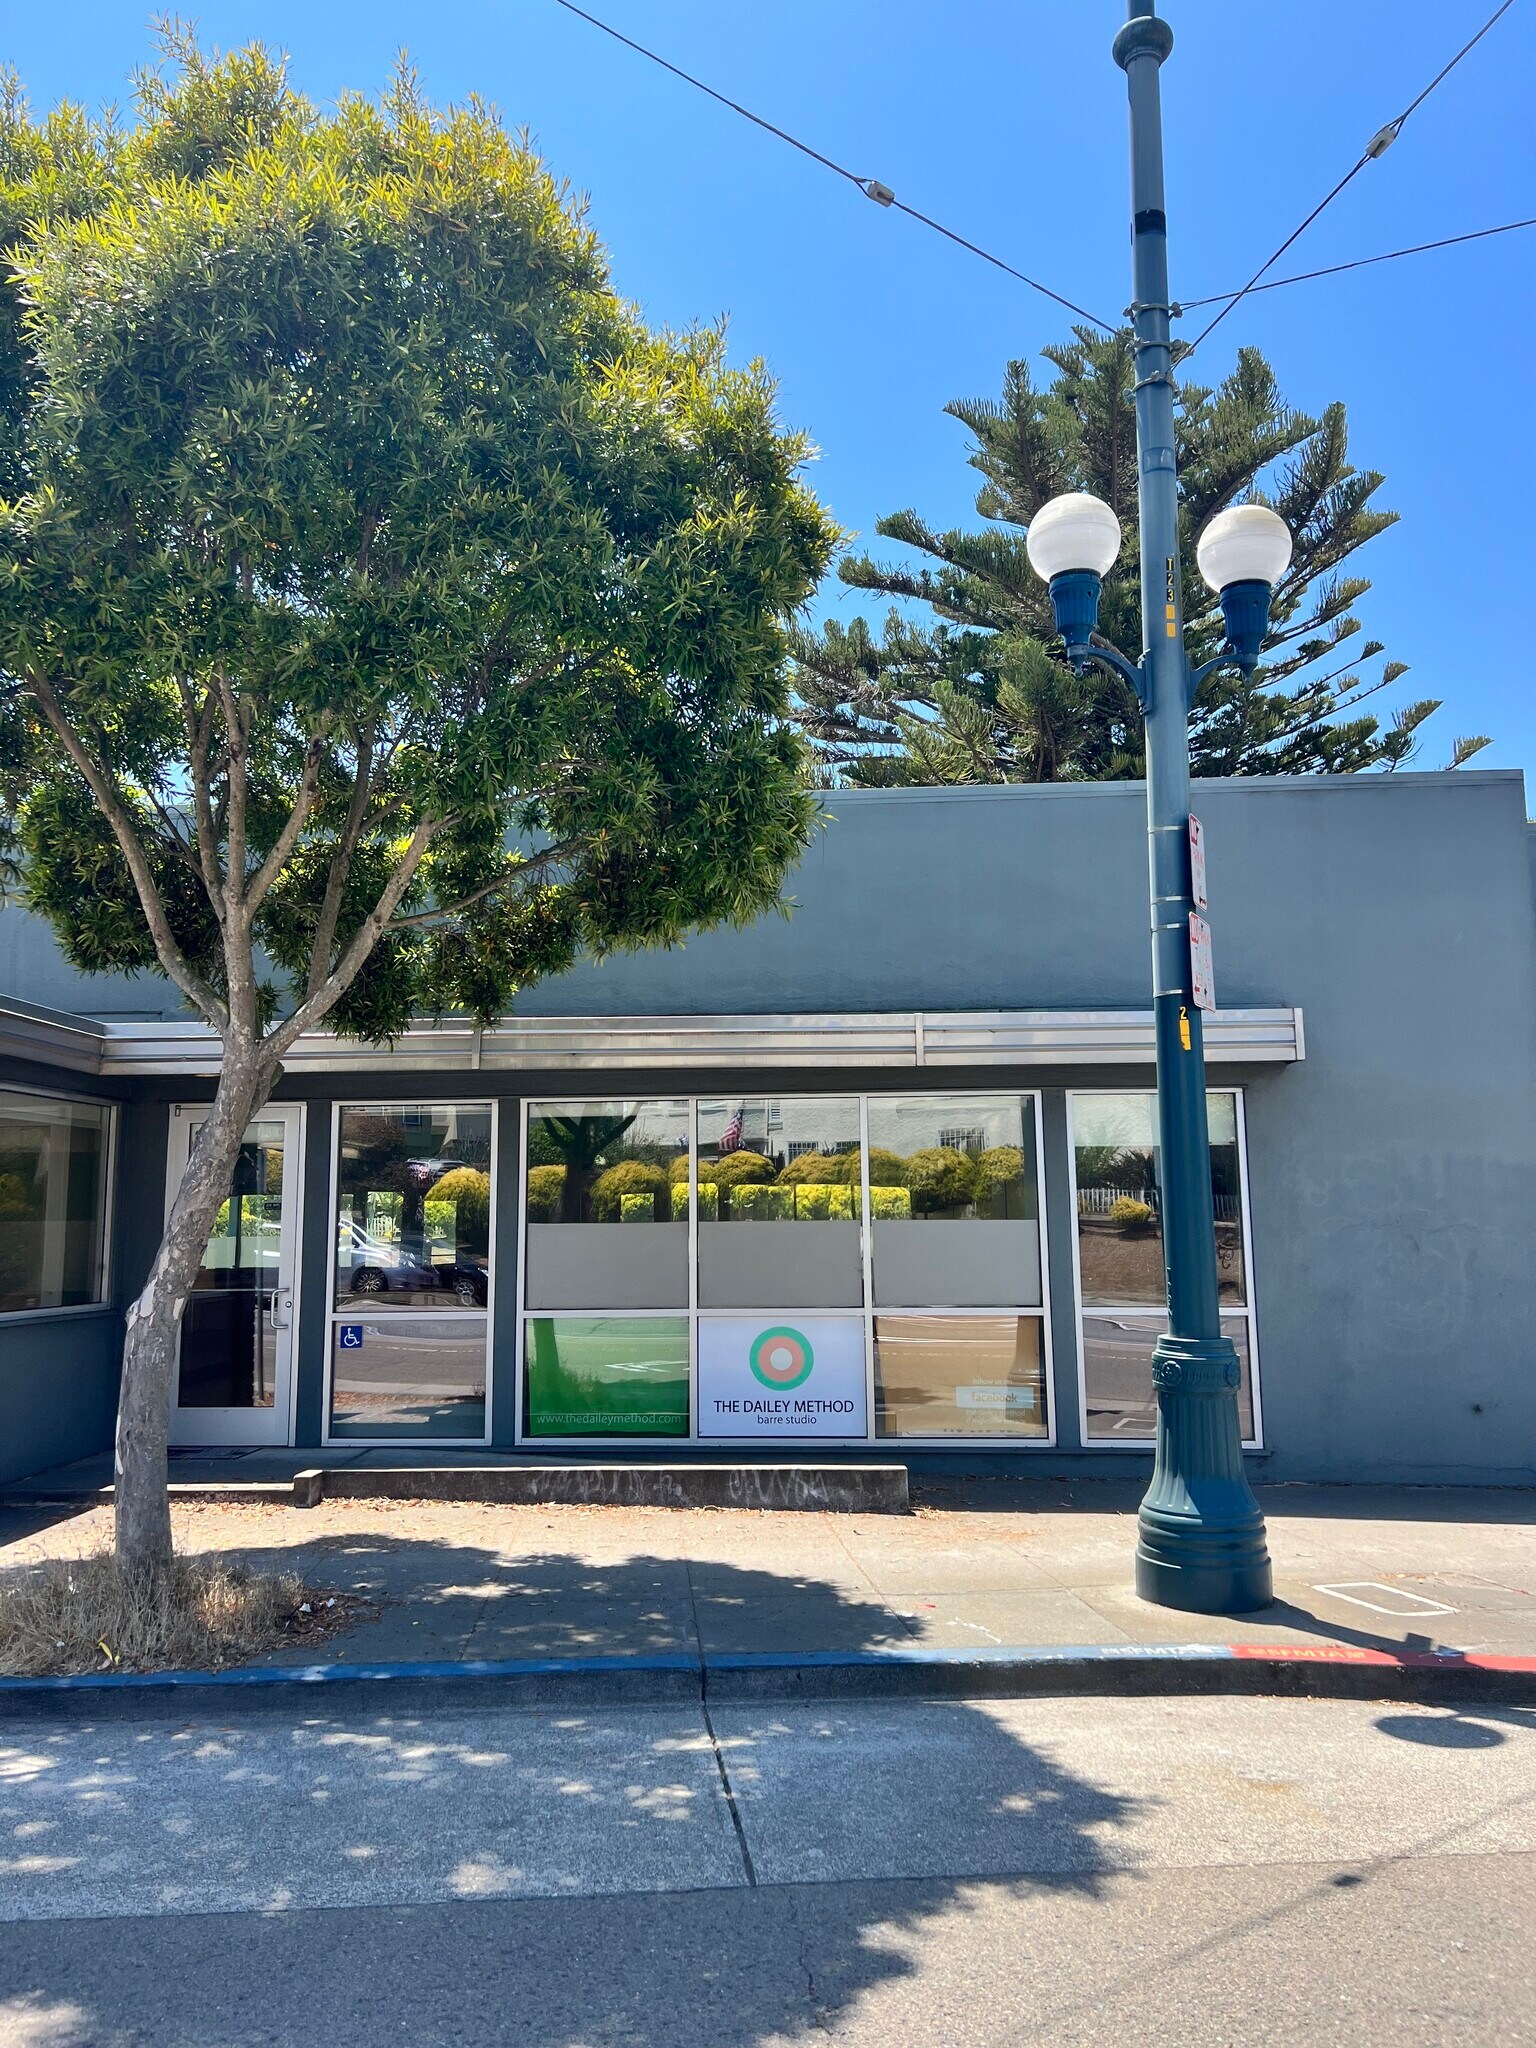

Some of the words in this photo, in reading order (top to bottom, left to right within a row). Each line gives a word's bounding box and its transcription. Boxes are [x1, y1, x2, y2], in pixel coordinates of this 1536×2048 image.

[971, 1392, 1018, 1403] facebook
[714, 1400, 740, 1413] THE
[743, 1400, 791, 1413] DAILEY
[794, 1400, 854, 1413] METHOD
[536, 1413, 681, 1426] www.thedaileymethod.com
[757, 1415, 784, 1424] barre
[786, 1414, 817, 1424] studio
